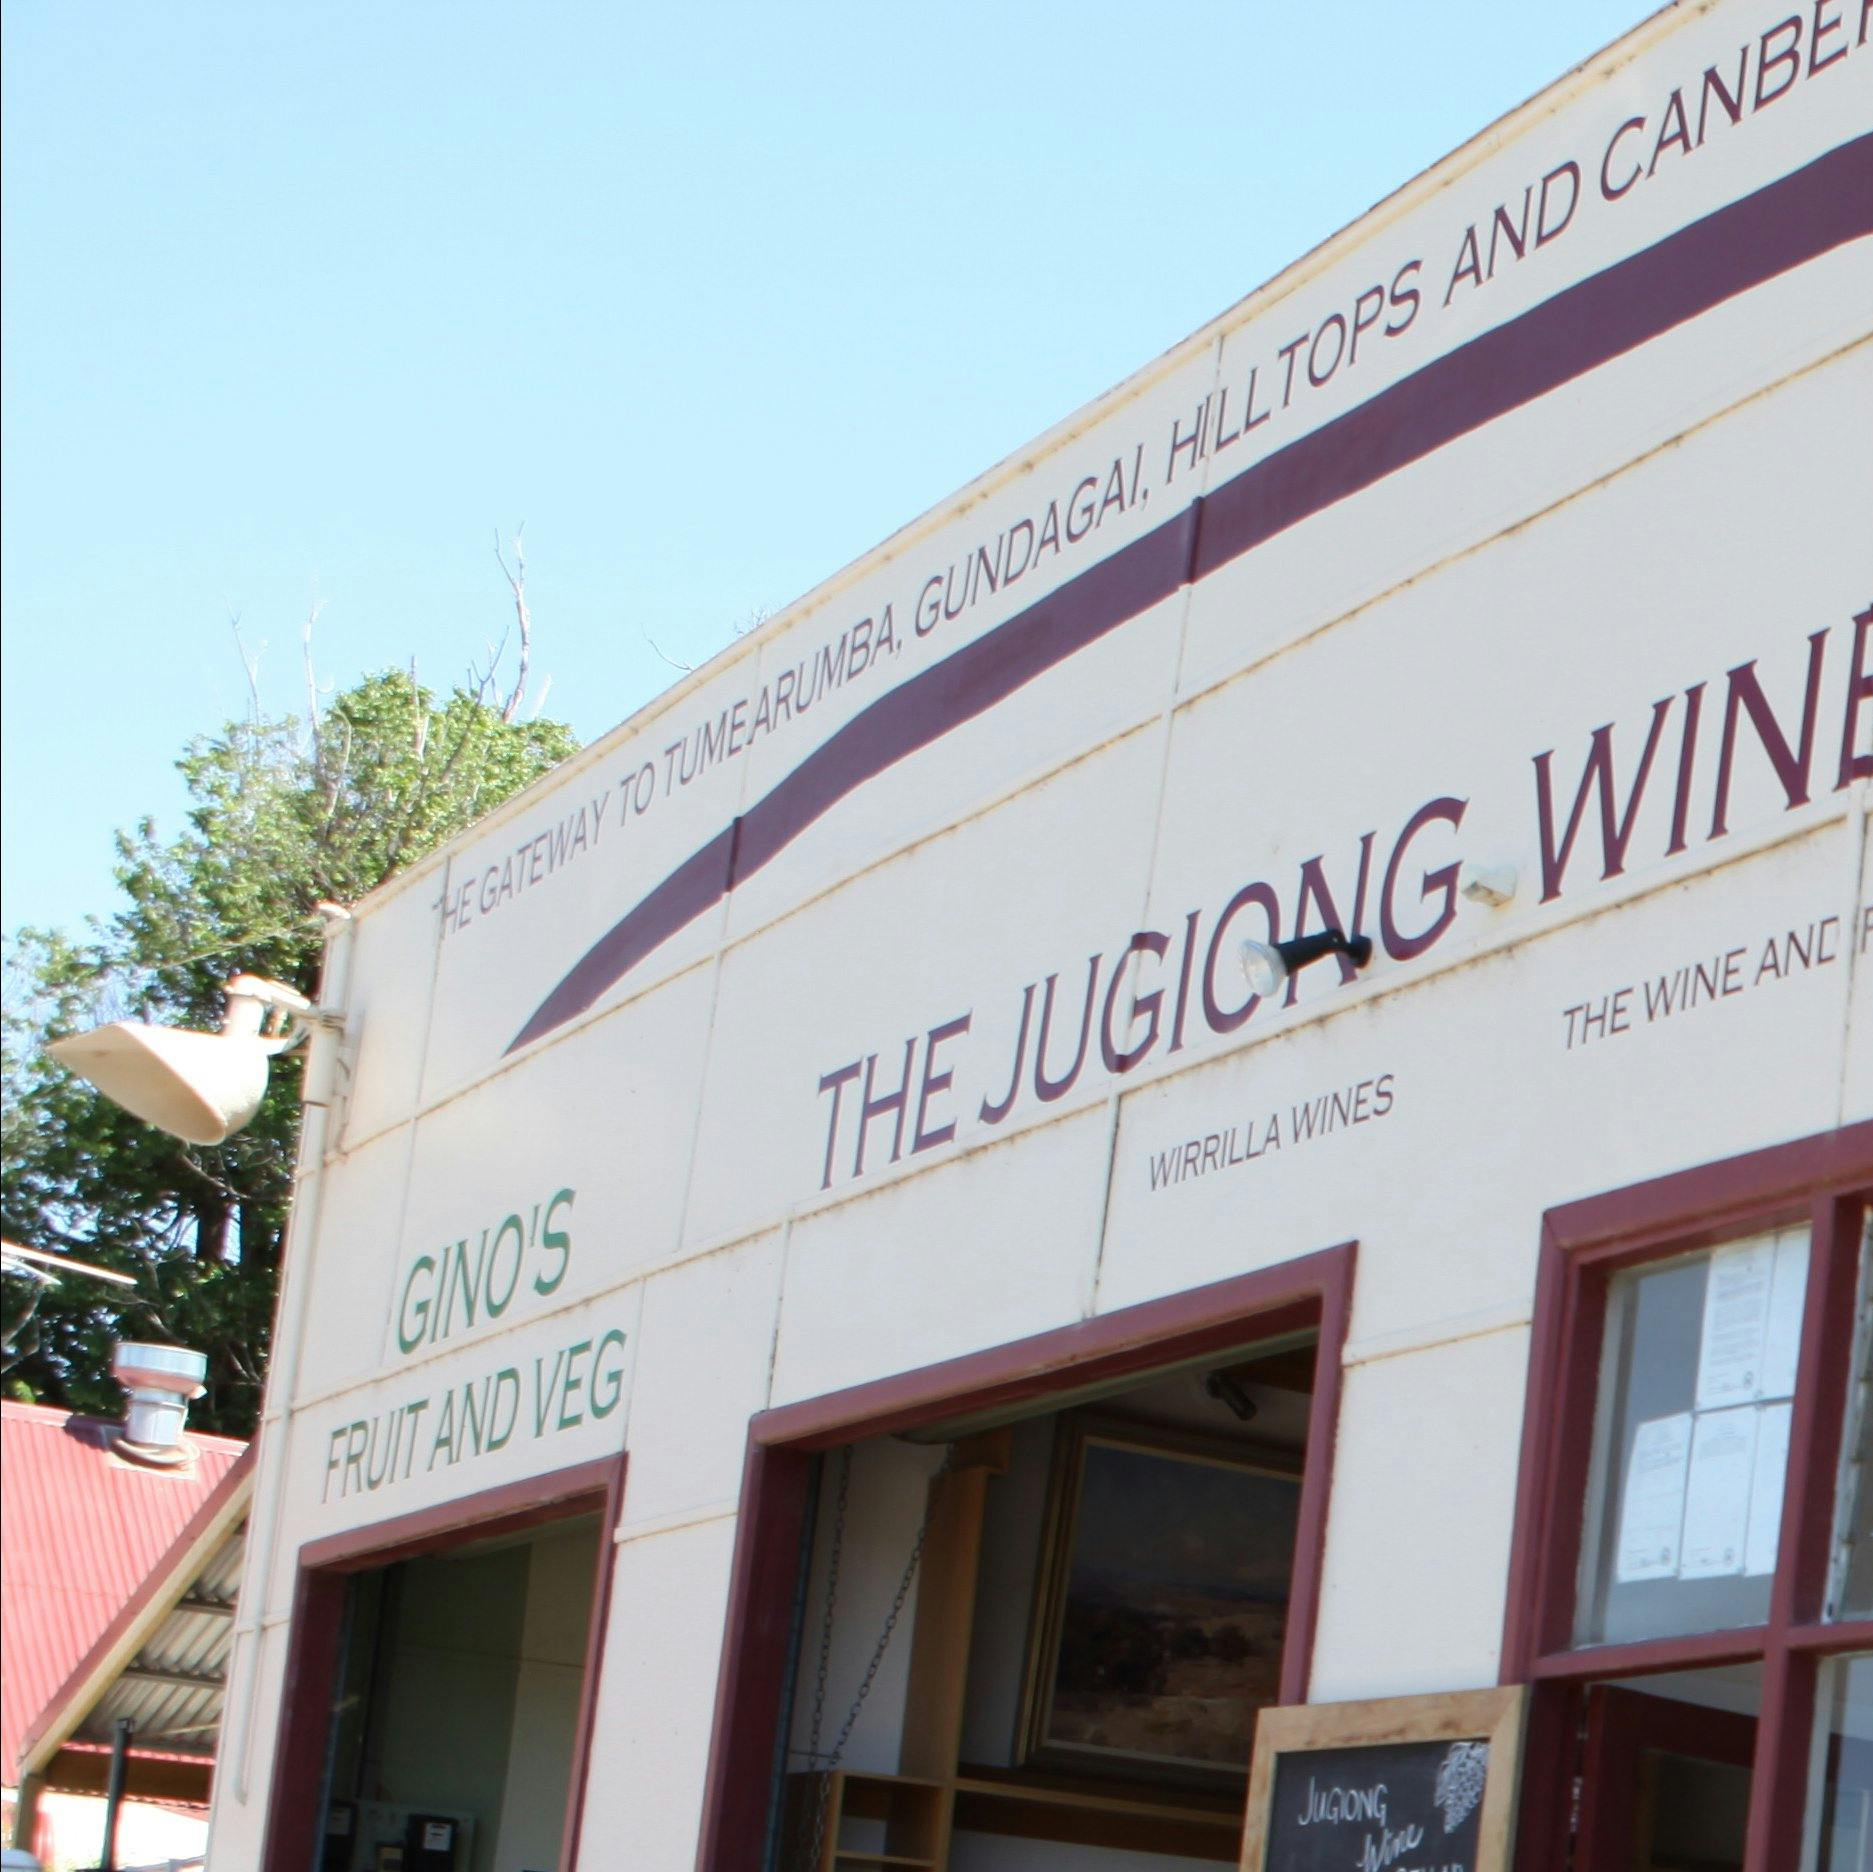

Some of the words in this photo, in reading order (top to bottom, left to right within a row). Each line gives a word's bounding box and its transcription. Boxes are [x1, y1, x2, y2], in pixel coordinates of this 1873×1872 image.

[480, 790, 610, 915] GATEWAY
[619, 761, 656, 827] TO
[915, 443, 1149, 639] GUNDAGAI,
[1166, 259, 1422, 485] HILLTOPS
[1443, 160, 1581, 309] AND
[817, 1007, 973, 1192] THE
[977, 795, 1470, 1126] JUGIONG
[1562, 987, 1634, 1050] THE
[1643, 947, 1748, 1025] WINE
[1150, 1113, 1281, 1192] WIRRILLA
[1291, 1073, 1395, 1144] WINES
[398, 1188, 576, 1355] GINO'S
[322, 1399, 430, 1504] FRUIT
[427, 1367, 521, 1473] AND
[533, 1328, 627, 1440] VEG
